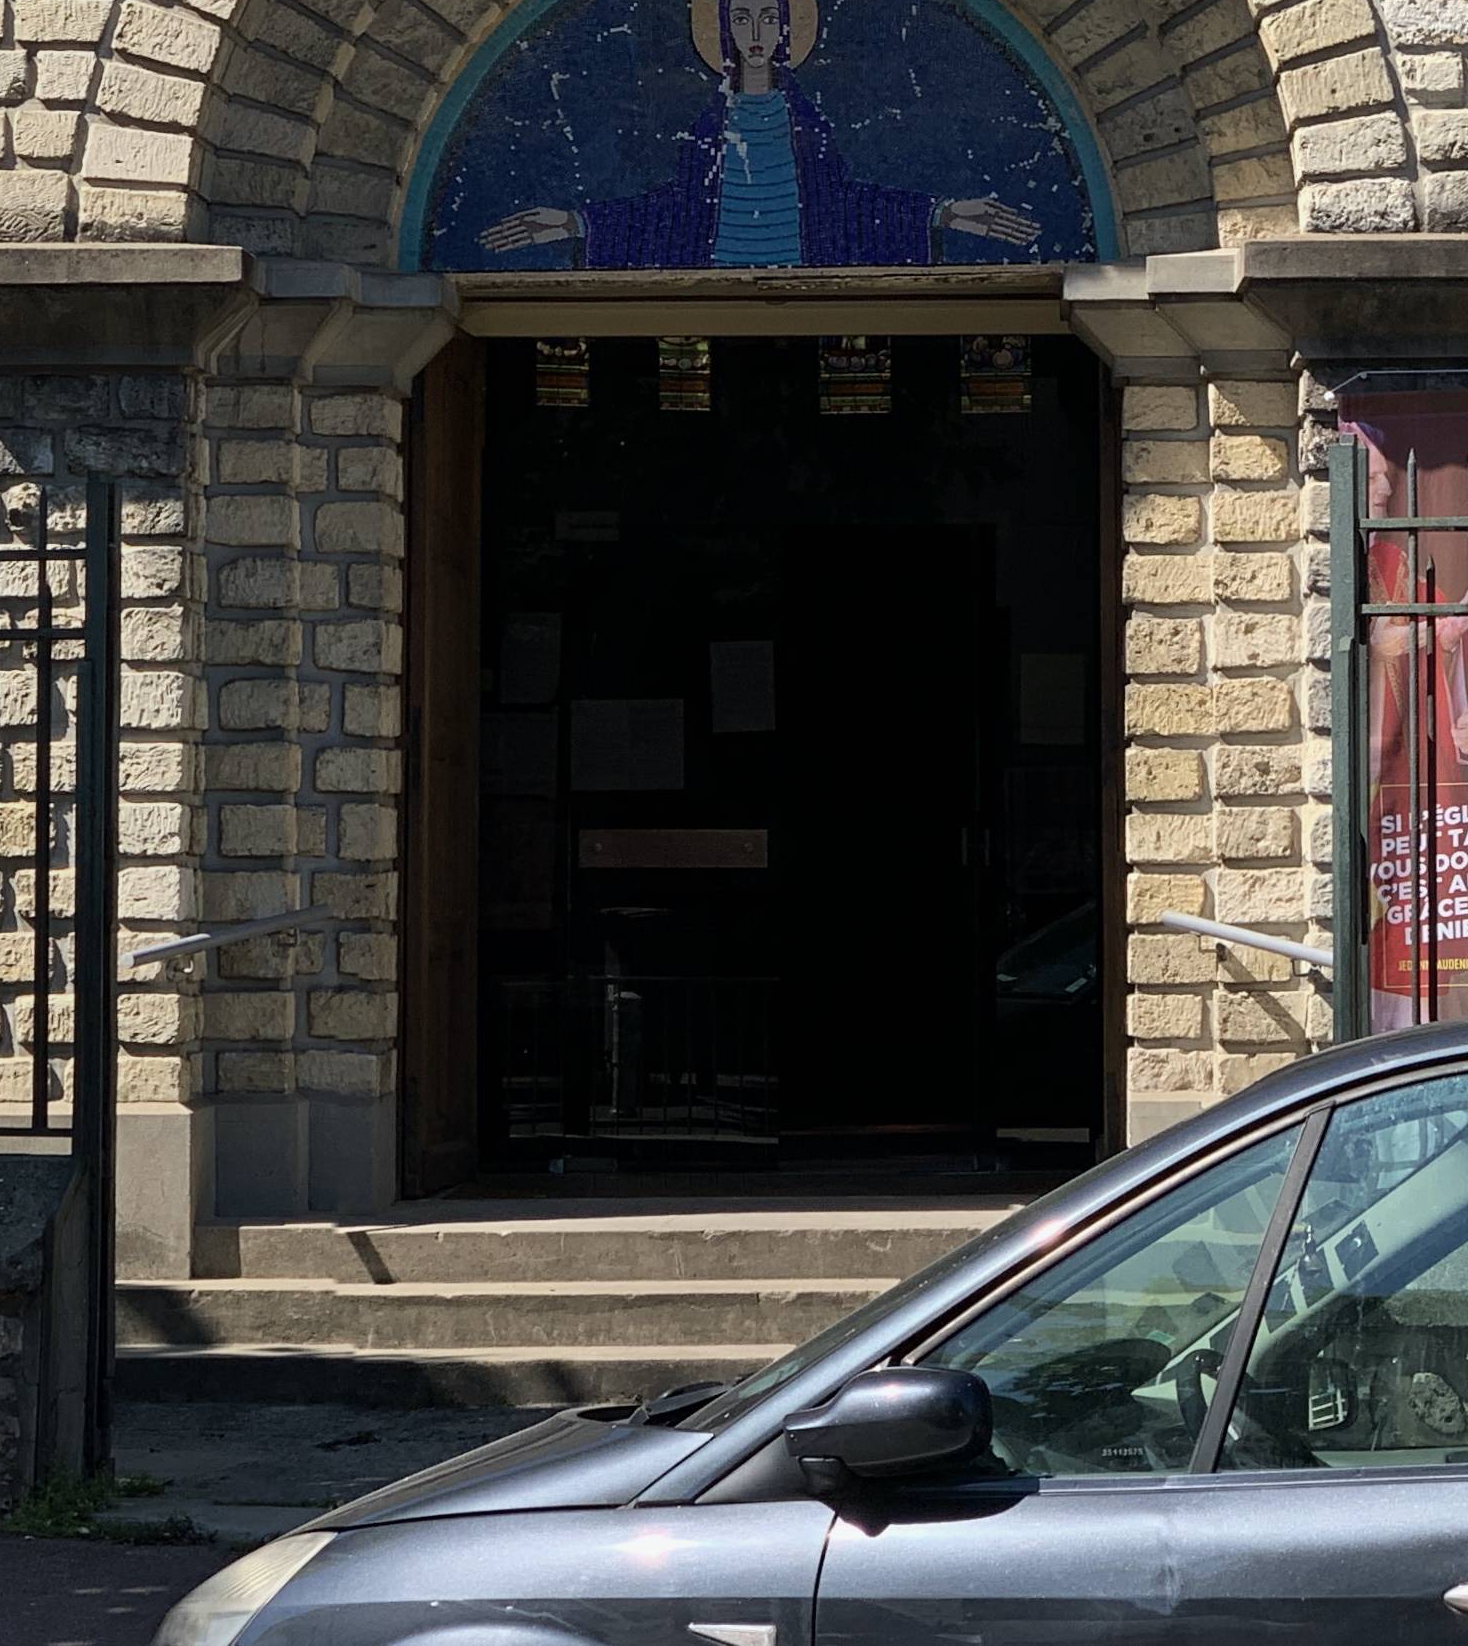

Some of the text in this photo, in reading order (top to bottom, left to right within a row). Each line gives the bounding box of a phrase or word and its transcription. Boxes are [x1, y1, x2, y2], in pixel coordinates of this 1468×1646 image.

[1381, 814, 1402, 834] SI
[1381, 831, 1443, 857] PEU
[1377, 876, 1443, 903] C'ES
